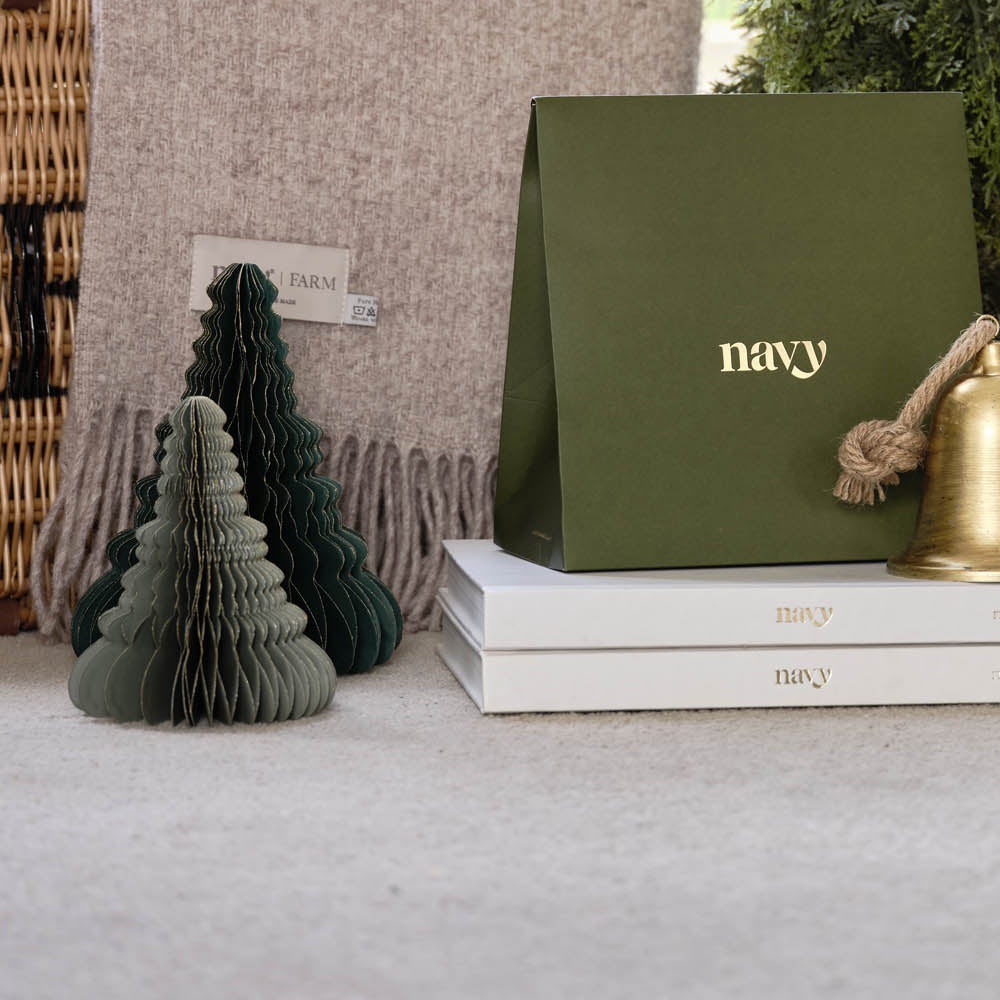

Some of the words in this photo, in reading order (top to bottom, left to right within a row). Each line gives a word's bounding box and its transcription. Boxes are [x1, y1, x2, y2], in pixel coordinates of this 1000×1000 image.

[290, 271, 337, 292] FARM
[719, 340, 827, 379] navy
[776, 606, 833, 628] navy
[775, 667, 832, 689] navy
